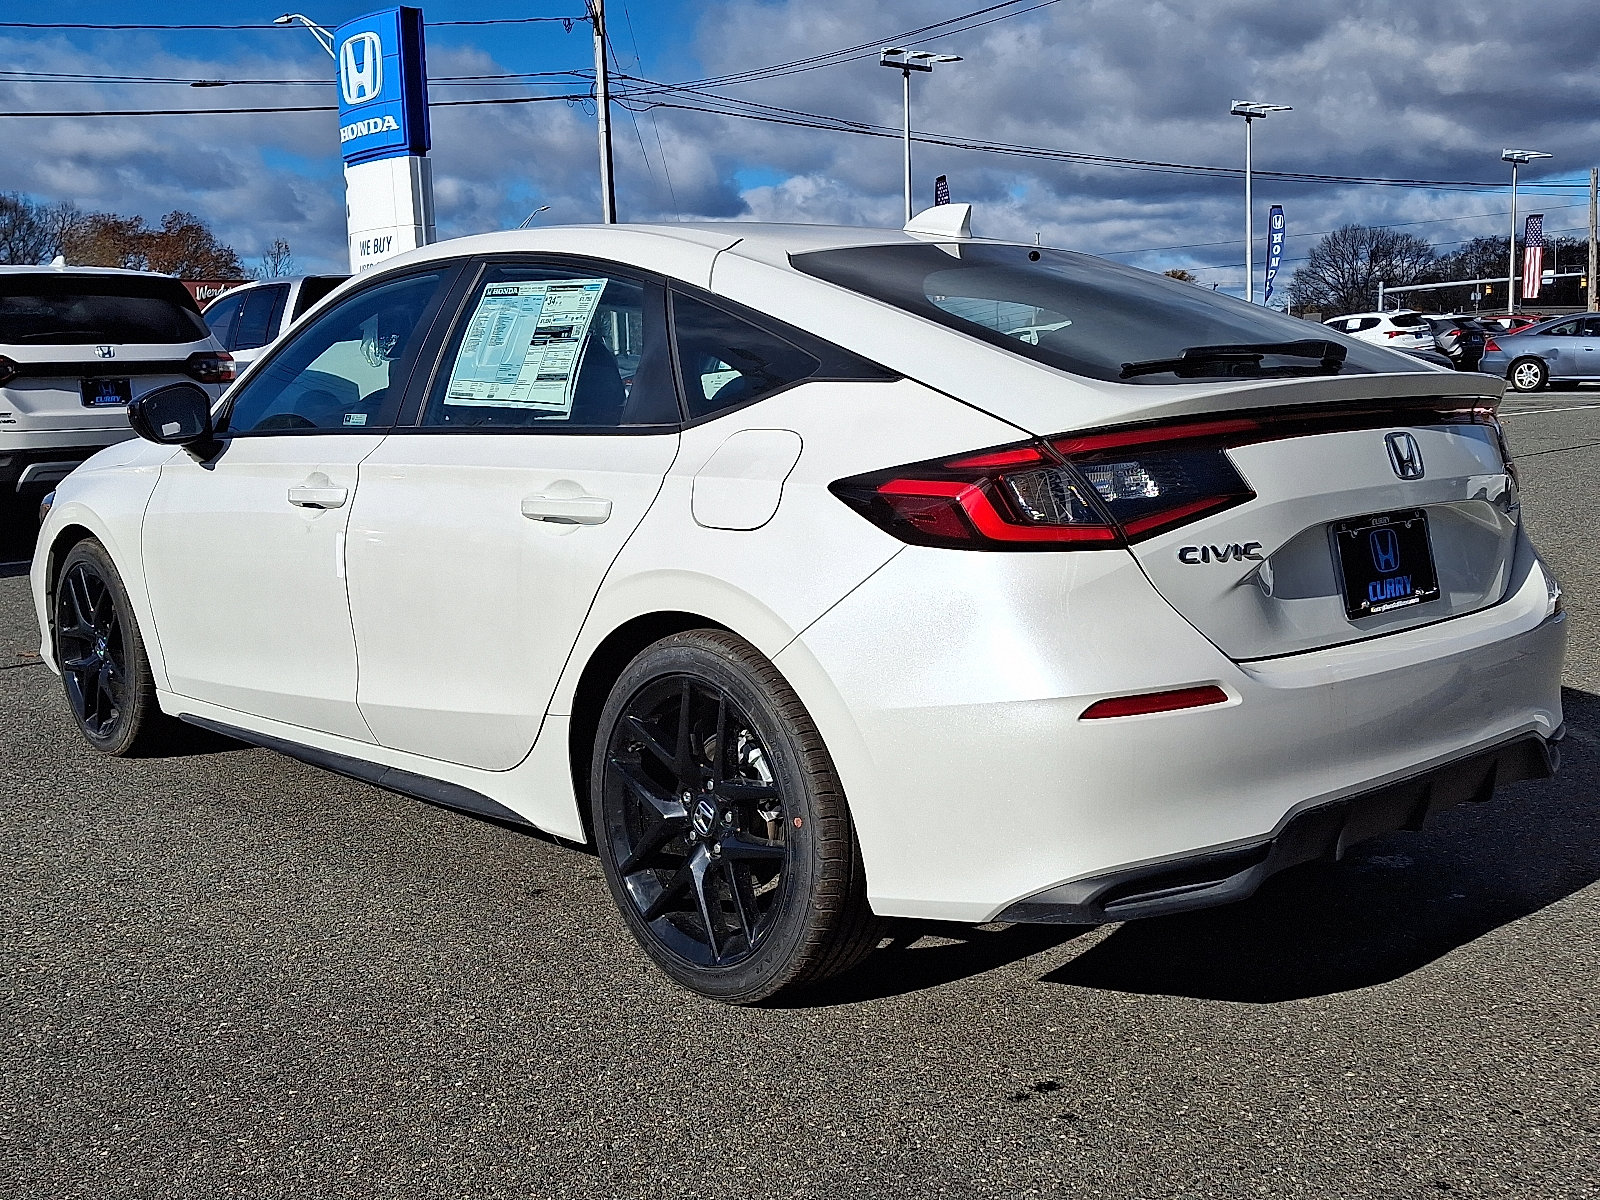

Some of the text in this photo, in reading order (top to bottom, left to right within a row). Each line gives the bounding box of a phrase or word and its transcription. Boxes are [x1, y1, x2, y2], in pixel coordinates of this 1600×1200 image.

[340, 115, 400, 143] HONDA
[360, 235, 393, 256] WE BUY
[492, 287, 519, 295] HONDA
[95, 395, 121, 403] CURRY
[1178, 541, 1264, 565] CIVIC
[1368, 575, 1412, 601] CURRY
